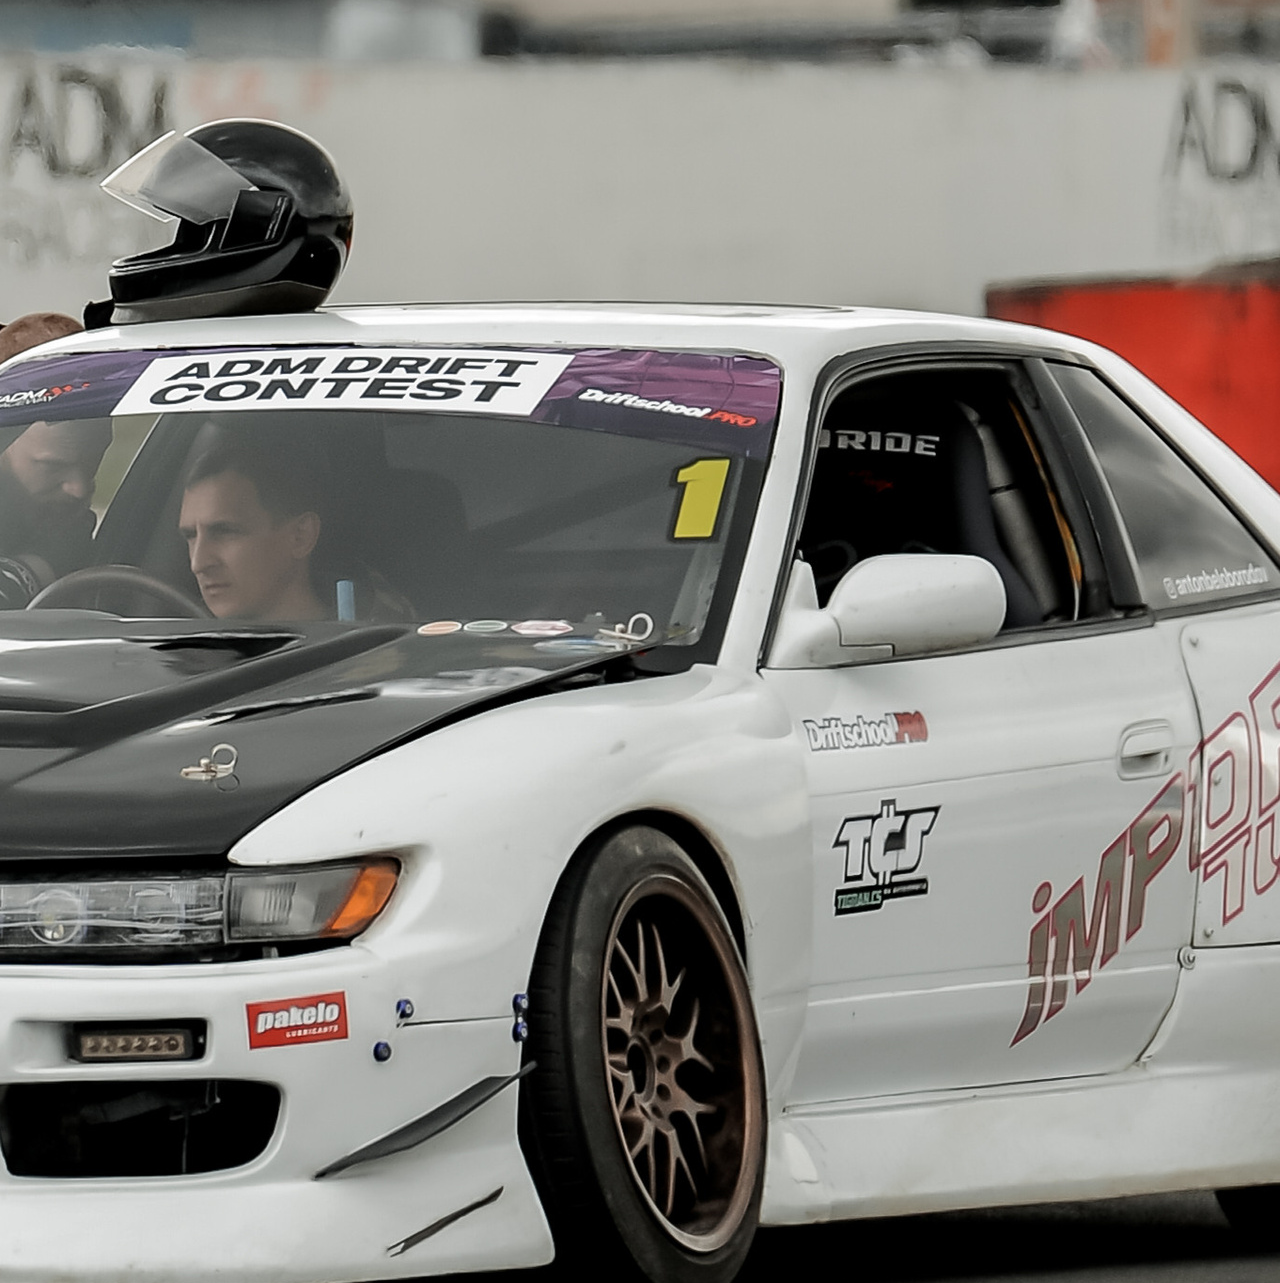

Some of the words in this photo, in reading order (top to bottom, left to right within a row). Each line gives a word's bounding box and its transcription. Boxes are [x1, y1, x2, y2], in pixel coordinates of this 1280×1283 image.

[1158, 73, 1280, 183] AD
[165, 356, 326, 381] ADM
[332, 356, 538, 378] DRIFT
[149, 377, 521, 405] CONTEST
[673, 458, 731, 539] 1
[257, 1001, 340, 1034] pakelo
